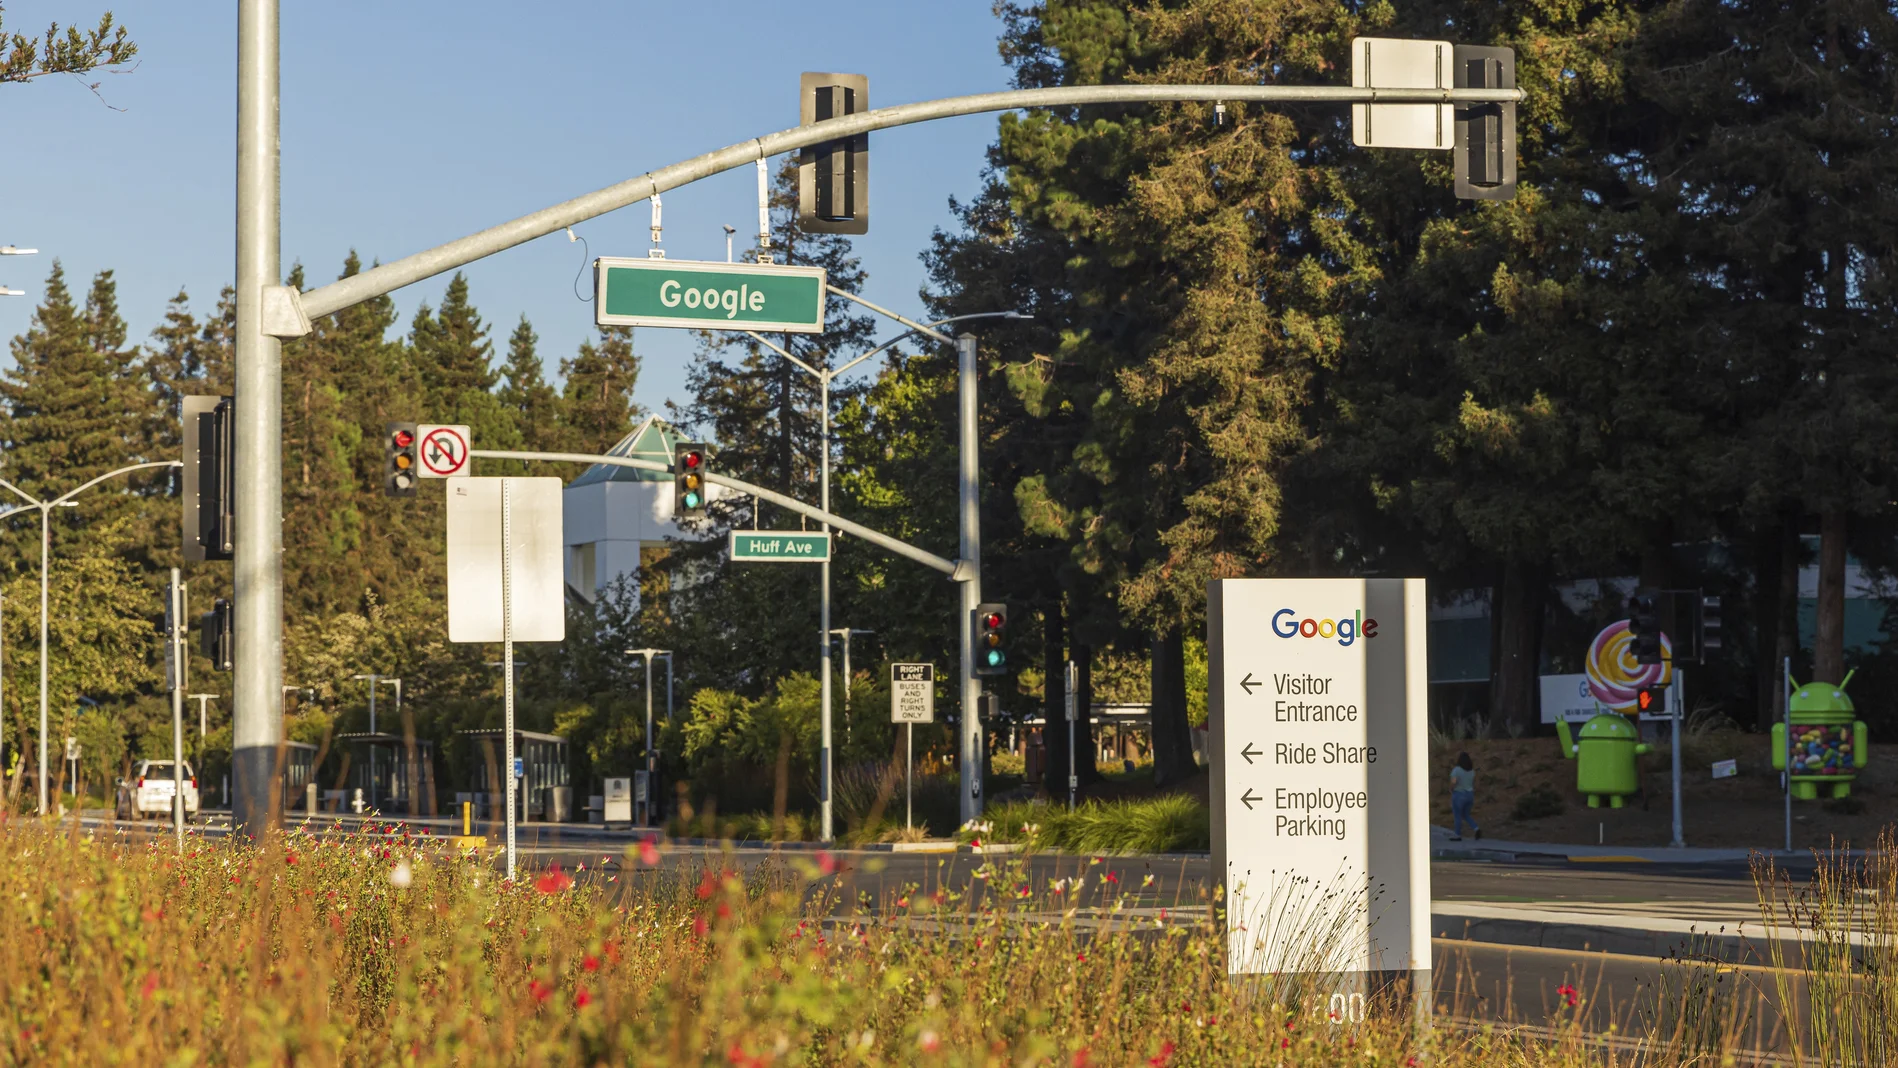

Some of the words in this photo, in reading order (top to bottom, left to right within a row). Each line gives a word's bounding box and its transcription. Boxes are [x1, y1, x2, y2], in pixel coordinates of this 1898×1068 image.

[660, 279, 766, 319] Google
[749, 540, 780, 555] Huff
[785, 540, 813, 555] Ave
[1271, 608, 1379, 647] Google
[900, 665, 925, 673] RIGHT
[901, 673, 924, 681] LANE
[1274, 673, 1332, 695] Visitor
[1274, 701, 1357, 722] Entrance
[1275, 742, 1317, 764] Ride
[1322, 742, 1378, 764] Share
[1275, 787, 1367, 813] Employee
[1275, 815, 1346, 841] Parking
